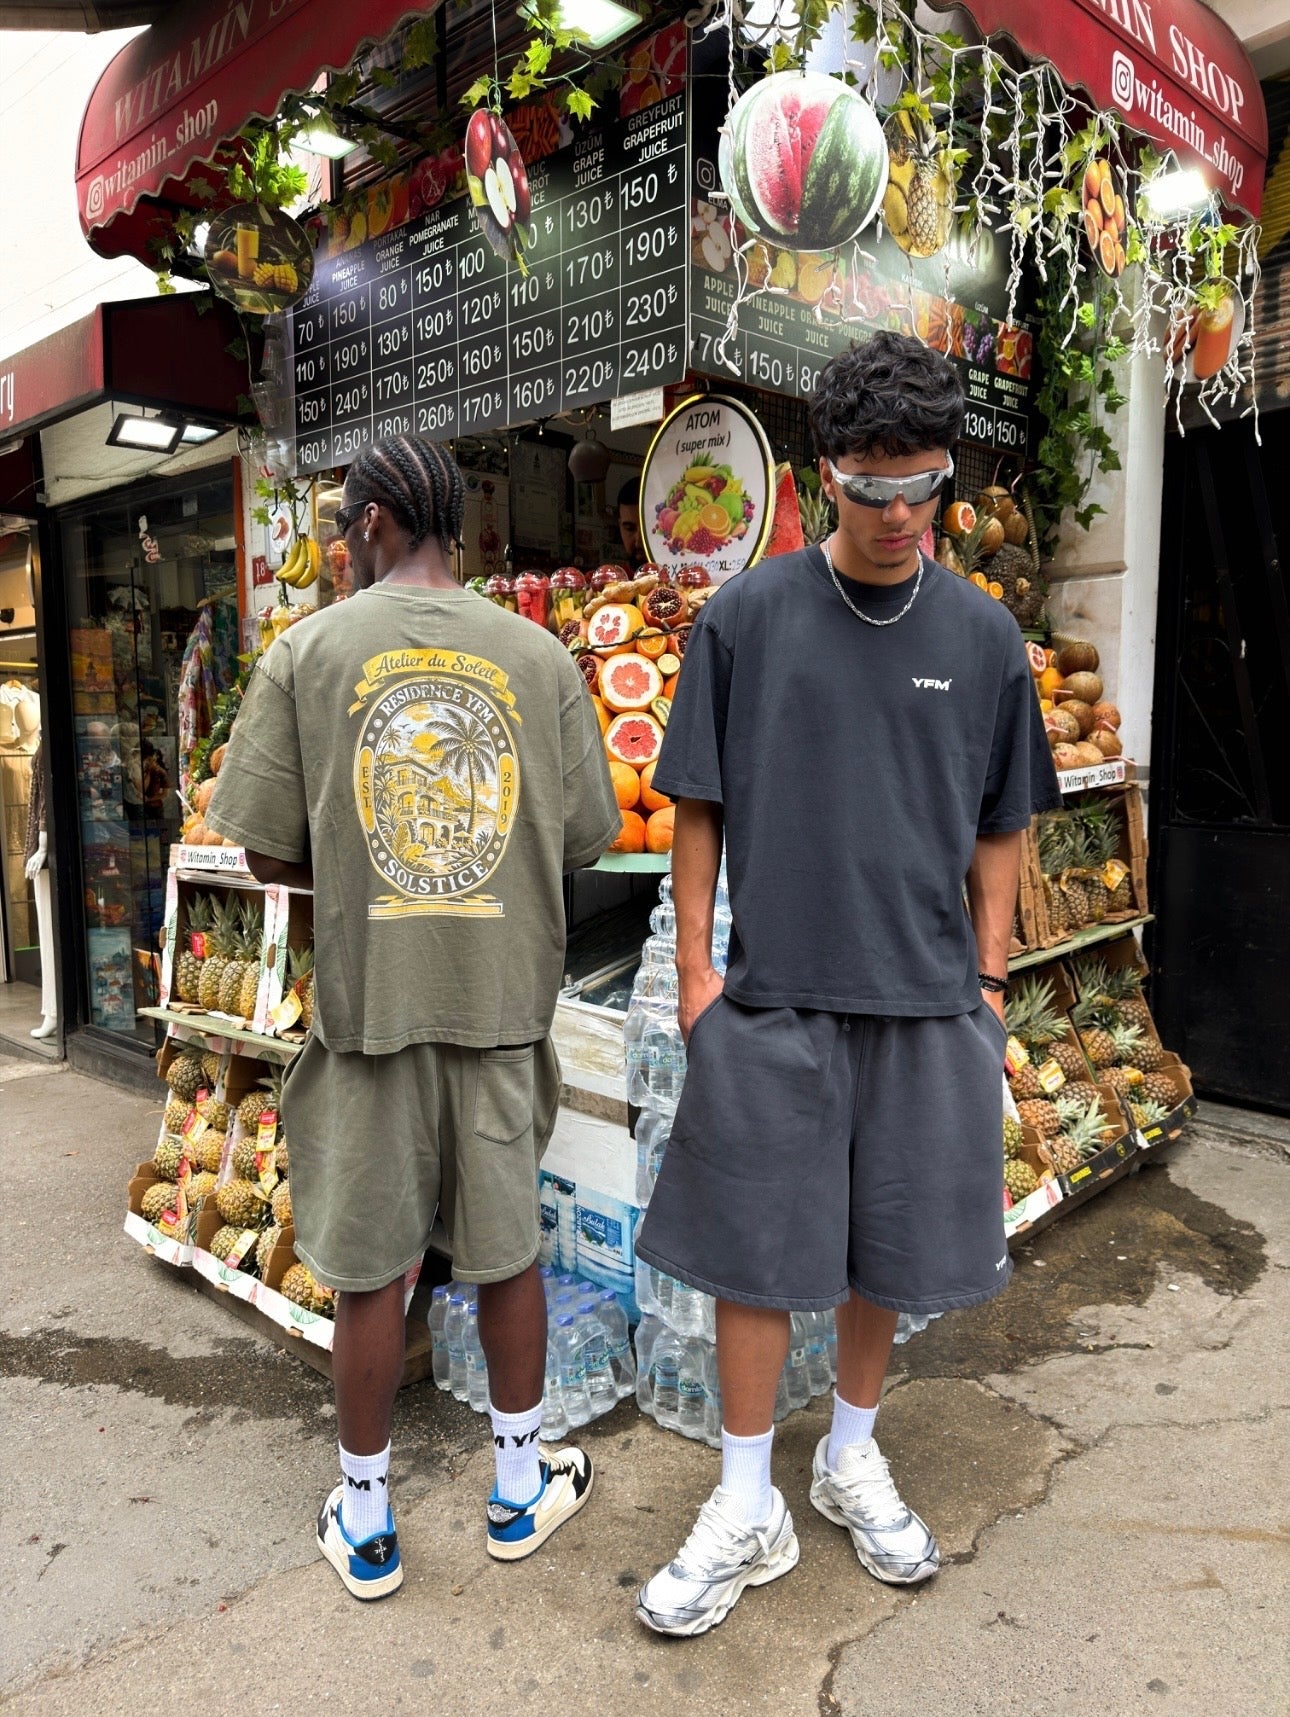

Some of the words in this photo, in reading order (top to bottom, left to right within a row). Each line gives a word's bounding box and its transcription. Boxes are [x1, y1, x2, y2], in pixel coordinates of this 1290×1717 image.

[1169, 24, 1245, 125] SHOP
[628, 95, 682, 131] GREYFURT
[623, 111, 684, 150] GRAPEFRUIT
[1134, 76, 1245, 196] witamin_shop
[103, 98, 219, 197] witamin_shop
[638, 137, 668, 163] JUICE
[527, 160, 546, 177] VUÇ
[573, 149, 605, 173] GRAPE
[527, 173, 550, 193] RROT
[575, 167, 603, 188] JUICE
[531, 190, 546, 207] ICE
[424, 210, 440, 225] NAR
[409, 214, 459, 247] POMEGRANATE
[375, 241, 404, 263] ORANGE
[422, 237, 445, 256] JUICE
[332, 260, 365, 284] PINEAPPLE
[380, 256, 400, 273] JUICE
[459, 248, 485, 279] 100
[339, 275, 358, 292] JUICE
[703, 275, 734, 298] APPLE
[302, 292, 320, 308] JUICE
[705, 296, 732, 316] JUICE
[746, 295, 796, 322] PINEAPPLE
[298, 320, 314, 345] 70
[758, 316, 784, 336] JUICE
[805, 329, 829, 348] JUICE
[968, 368, 989, 385] GRAPE
[993, 377, 1028, 397] GRAPEFRUIT
[969, 384, 988, 400] JUICE
[1002, 394, 1018, 409] JUICE
[685, 408, 721, 431] ATOM
[374, 652, 425, 678] Atelier
[427, 652, 447, 669] du
[450, 654, 498, 683] Soleil
[911, 677, 952, 692] YFM
[379, 683, 462, 718] RESIDENCE
[465, 694, 495, 725] YFM
[501, 771, 513, 825] 2019
[383, 859, 490, 895] SOLSTICE
